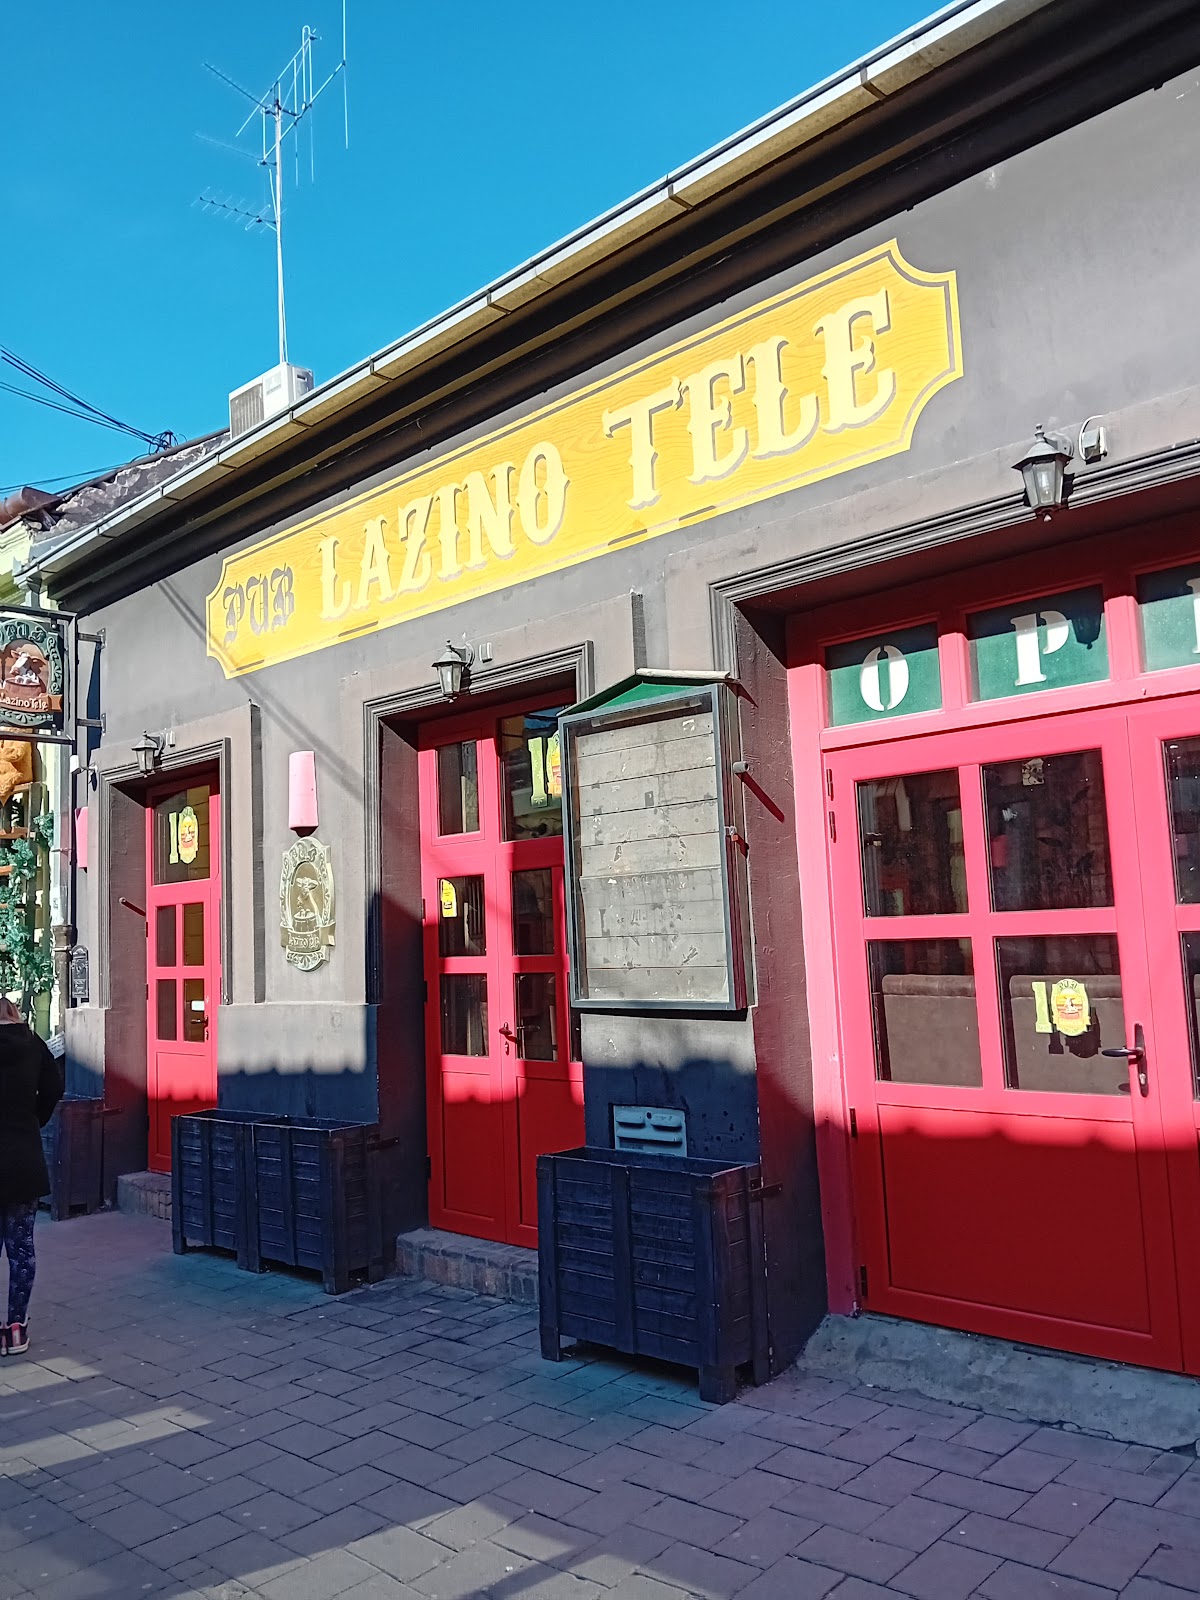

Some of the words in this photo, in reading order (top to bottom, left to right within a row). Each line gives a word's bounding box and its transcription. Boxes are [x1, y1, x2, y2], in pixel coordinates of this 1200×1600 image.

[223, 562, 295, 648] PUB
[318, 441, 570, 621] LAZINO
[602, 287, 897, 511] TELE
